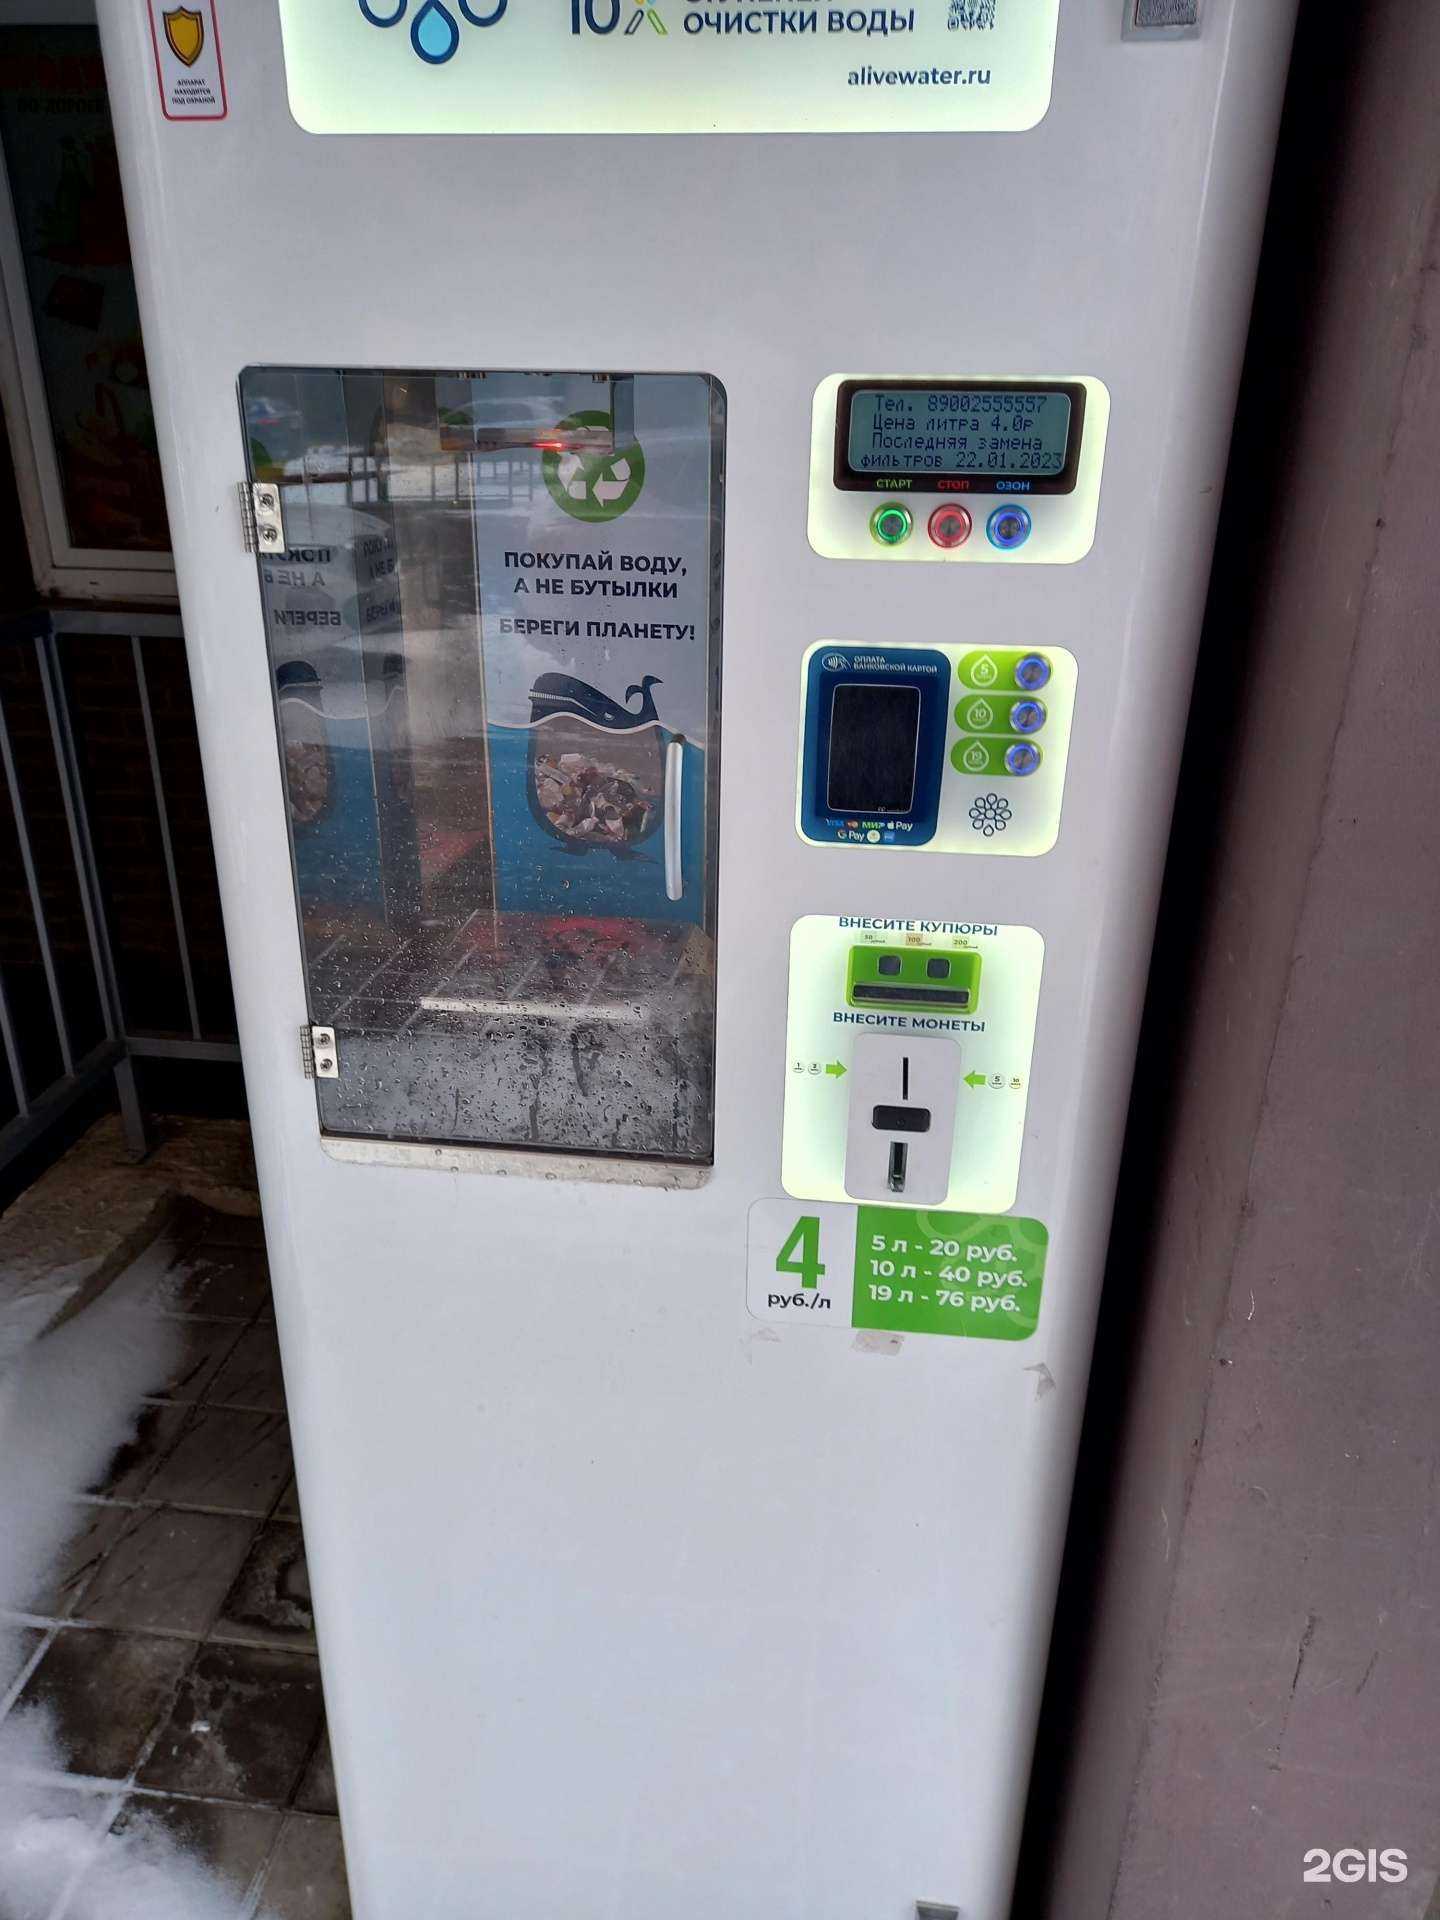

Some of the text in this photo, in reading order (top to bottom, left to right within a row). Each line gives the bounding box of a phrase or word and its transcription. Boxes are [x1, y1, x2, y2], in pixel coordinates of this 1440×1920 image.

[683, 8, 914, 36] ОЧИСТКИ ВОДЫ
[848, 65, 991, 86] alivewater.ru
[874, 395, 913, 411] Тел.
[873, 415, 915, 431] Цена
[926, 419, 980, 432] литра
[872, 433, 1043, 450] Последняя замена
[956, 452, 1063, 469] 22.01.2023
[876, 479, 912, 489] СТАРТ
[937, 480, 970, 490] СТОП
[996, 480, 1030, 491] ОЗОН
[504, 551, 687, 576] ПОКУПАЙ ВОДУ,
[514, 578, 678, 598] А НЕ БУТЫЛКИ
[500, 618, 695, 640] БЕРЕГИ ПЛАНЕТУ!
[853, 662, 938, 673] БАНКОВСКОЙ КАРТОЙ
[854, 655, 886, 663] ОПЛАТА
[980, 664, 989, 674] 5
[974, 709, 987, 719] 10
[896, 821, 914, 832] Pay
[848, 830, 865, 842] Pay
[838, 916, 998, 936] ВНЕСИТЕ КУПЮРЫ
[833, 1011, 985, 1032] ВНЕСИТЕ МОНЕТЫ
[775, 1216, 826, 1289] 4
[871, 1234, 886, 1251] 5
[891, 1239, 907, 1253] л
[929, 1239, 959, 1257] 20
[966, 1243, 1018, 1262] руб.
[870, 1259, 895, 1276] 10
[900, 1264, 916, 1278] л
[939, 1266, 971, 1283] 40
[977, 1268, 1028, 1288] руб.
[767, 1292, 831, 1309] руб./л
[869, 1284, 893, 1301] 19
[898, 1289, 914, 1303] л
[935, 1290, 964, 1307] 76
[971, 1293, 1021, 1313] руб.
